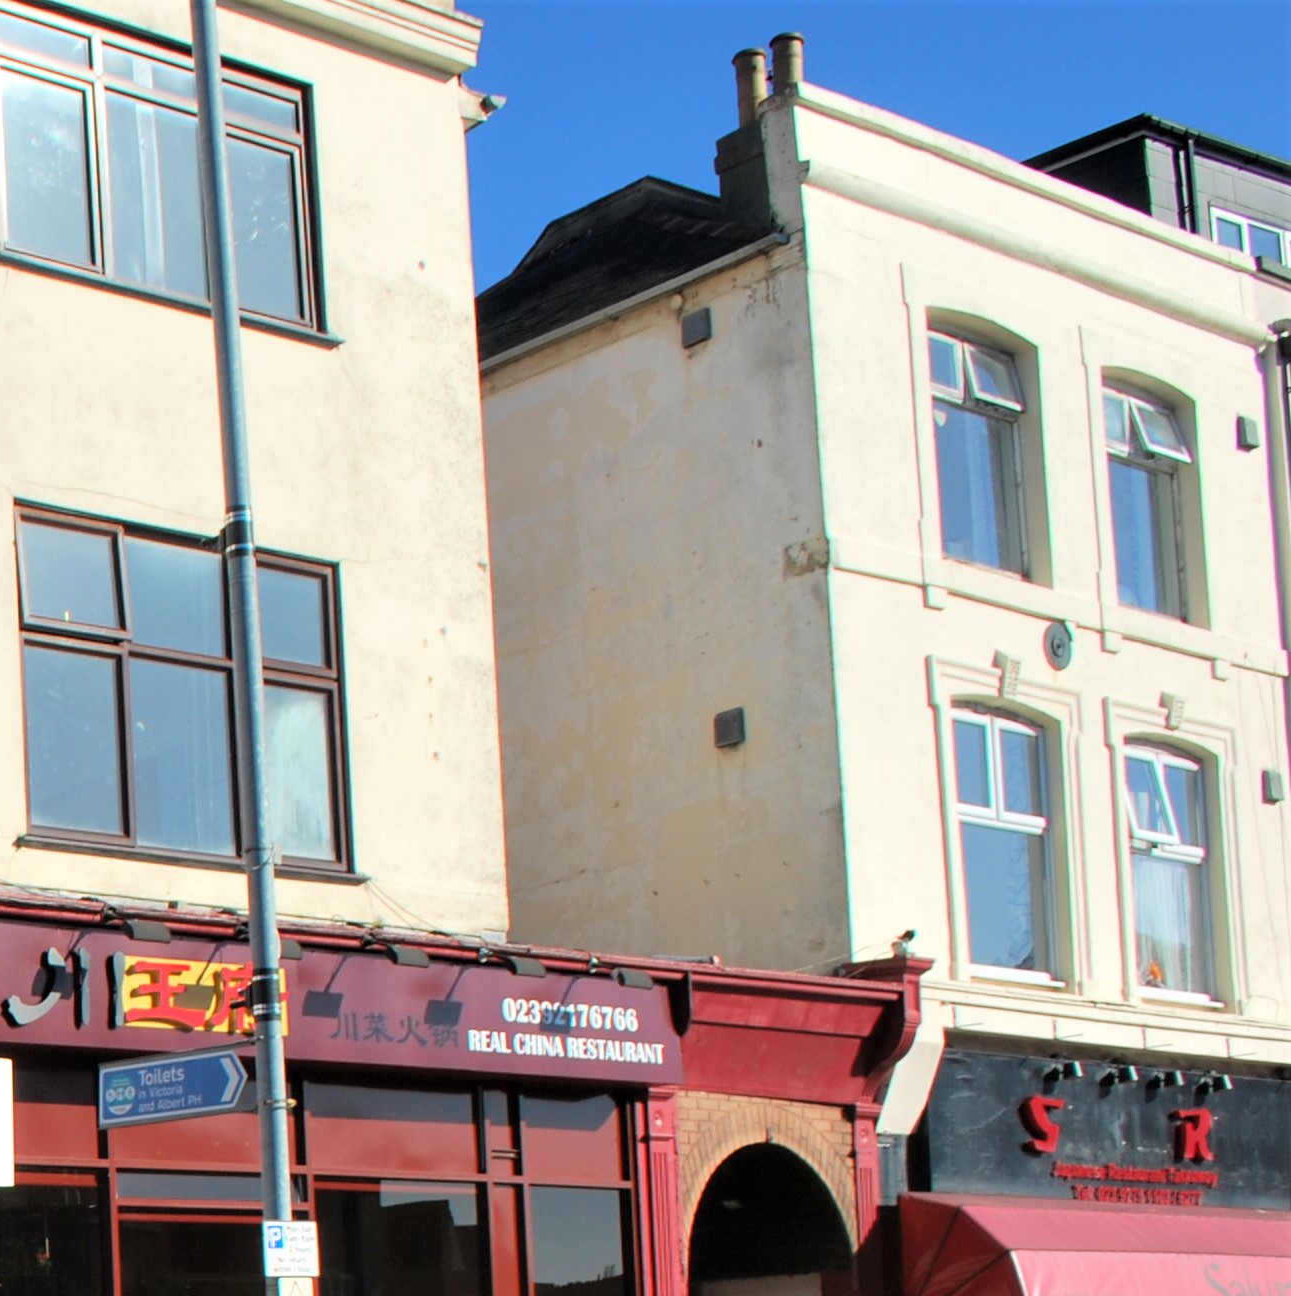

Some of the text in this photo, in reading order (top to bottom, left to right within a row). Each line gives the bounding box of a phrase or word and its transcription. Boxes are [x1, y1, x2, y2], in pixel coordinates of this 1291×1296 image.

[502, 997, 639, 1033] 02392176766
[467, 1029, 665, 1065] REAL CHINA RESTAURANT
[138, 1067, 185, 1086] Toilets
[138, 1084, 184, 1098] in Victoria
[138, 1101, 155, 1113] and
[157, 1096, 186, 1110] Albert
[188, 1094, 202, 1106] PH
[1029, 1094, 1215, 1161] S R
